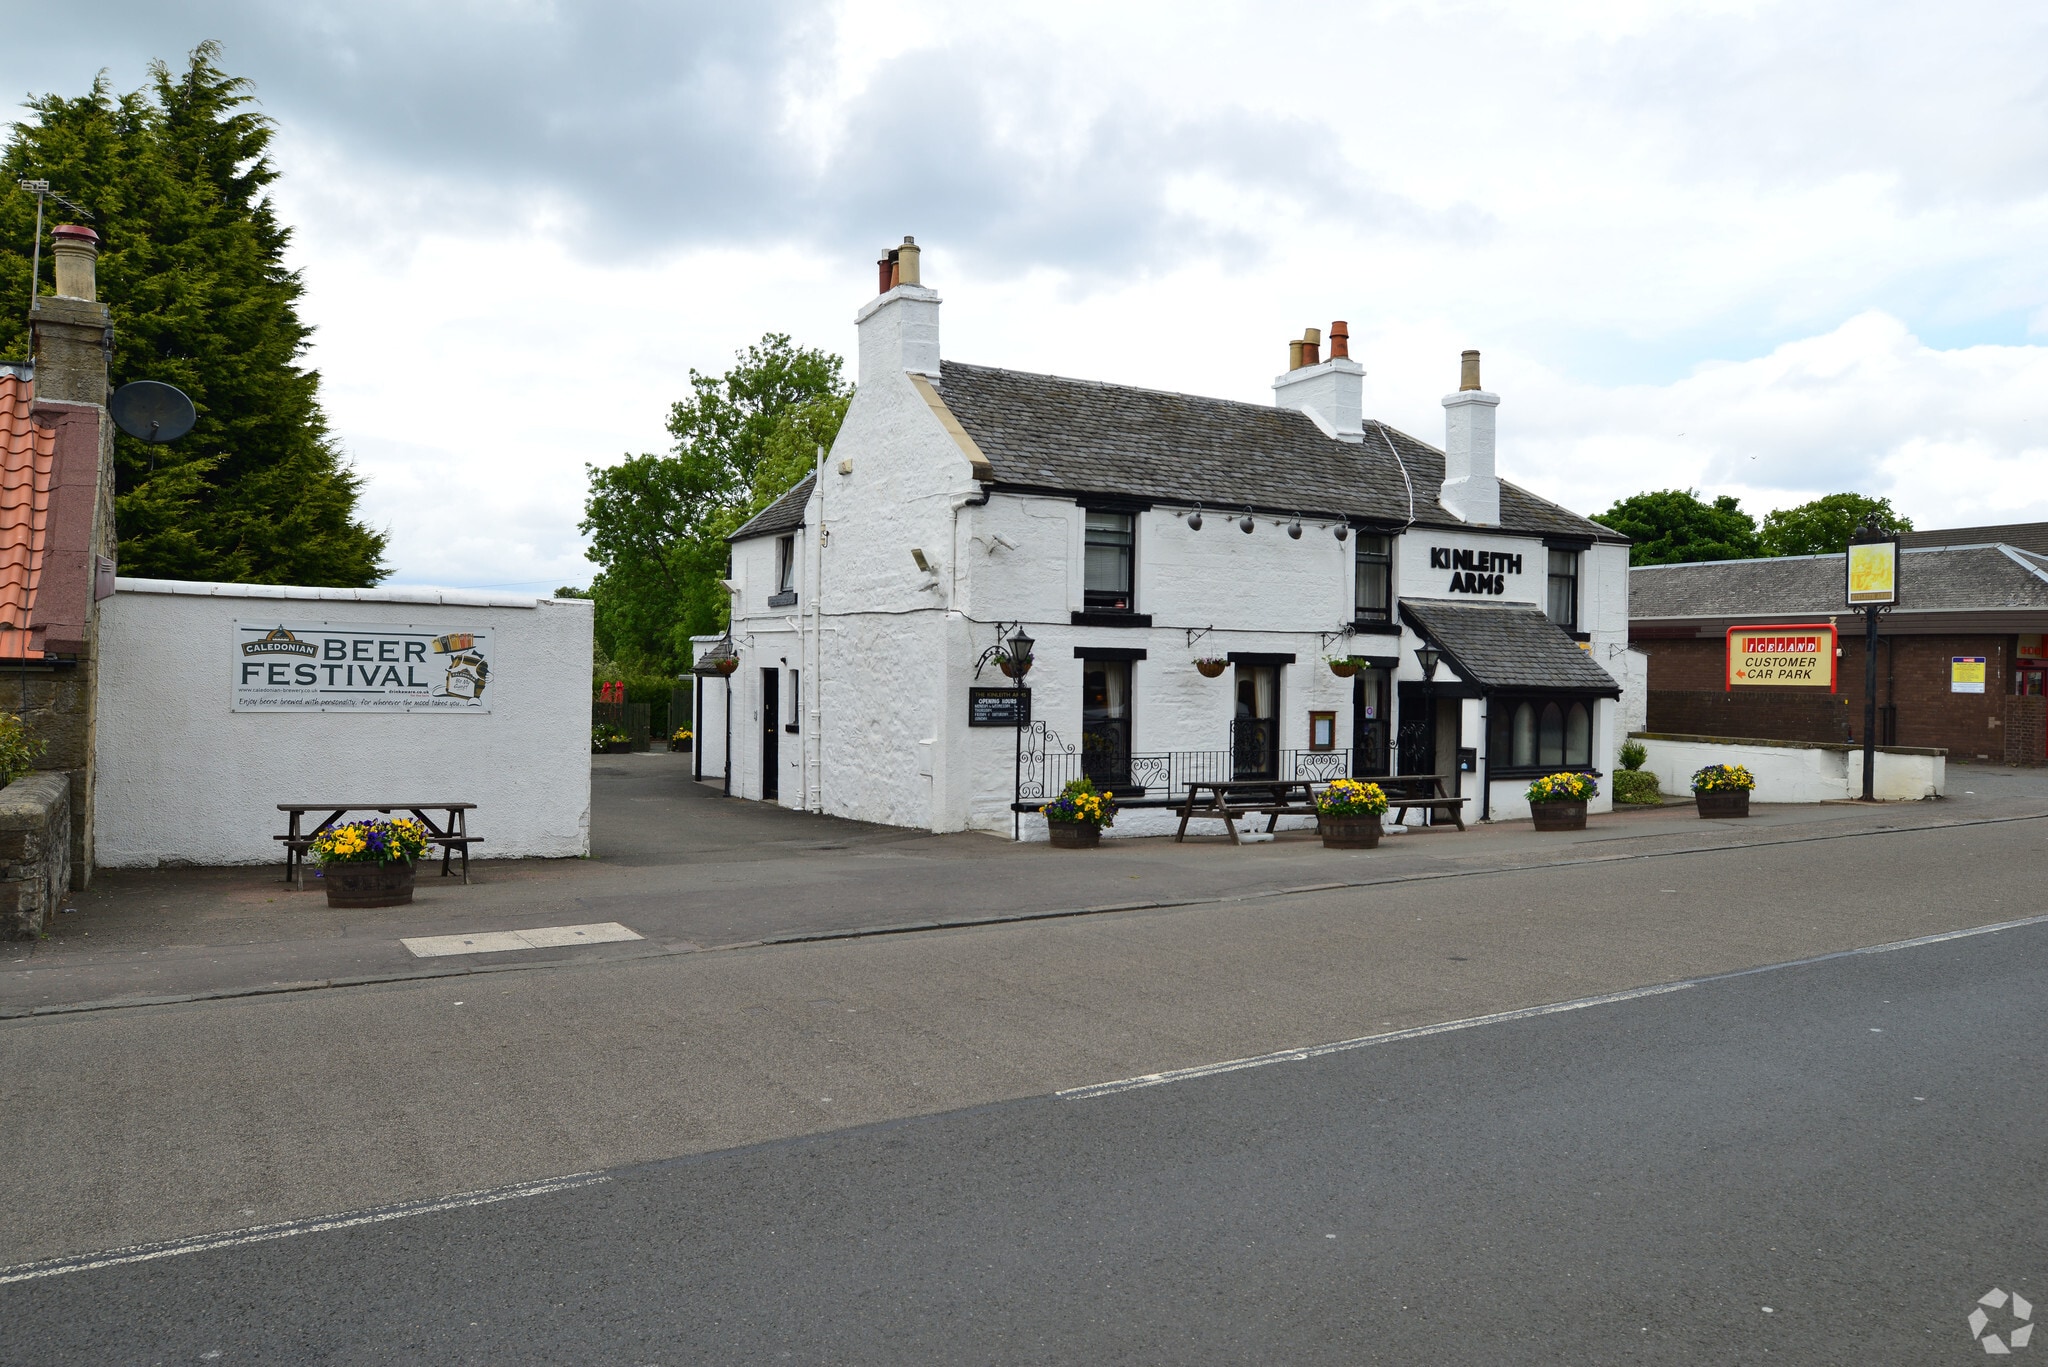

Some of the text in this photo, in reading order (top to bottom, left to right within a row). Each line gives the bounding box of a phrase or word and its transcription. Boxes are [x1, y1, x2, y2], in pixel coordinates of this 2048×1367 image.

[1431, 547, 1522, 574] KINLEITH
[1449, 571, 1504, 595] ARMS
[246, 644, 313, 654] CALEDONIAN
[323, 639, 426, 662] BEER
[1748, 643, 1815, 652] ICELAND
[1745, 657, 1816, 667] CUSTOMER
[241, 662, 428, 687] FESTIVAL
[1747, 669, 1812, 679] CAR PARK
[239, 698, 257, 706] Enjoy
